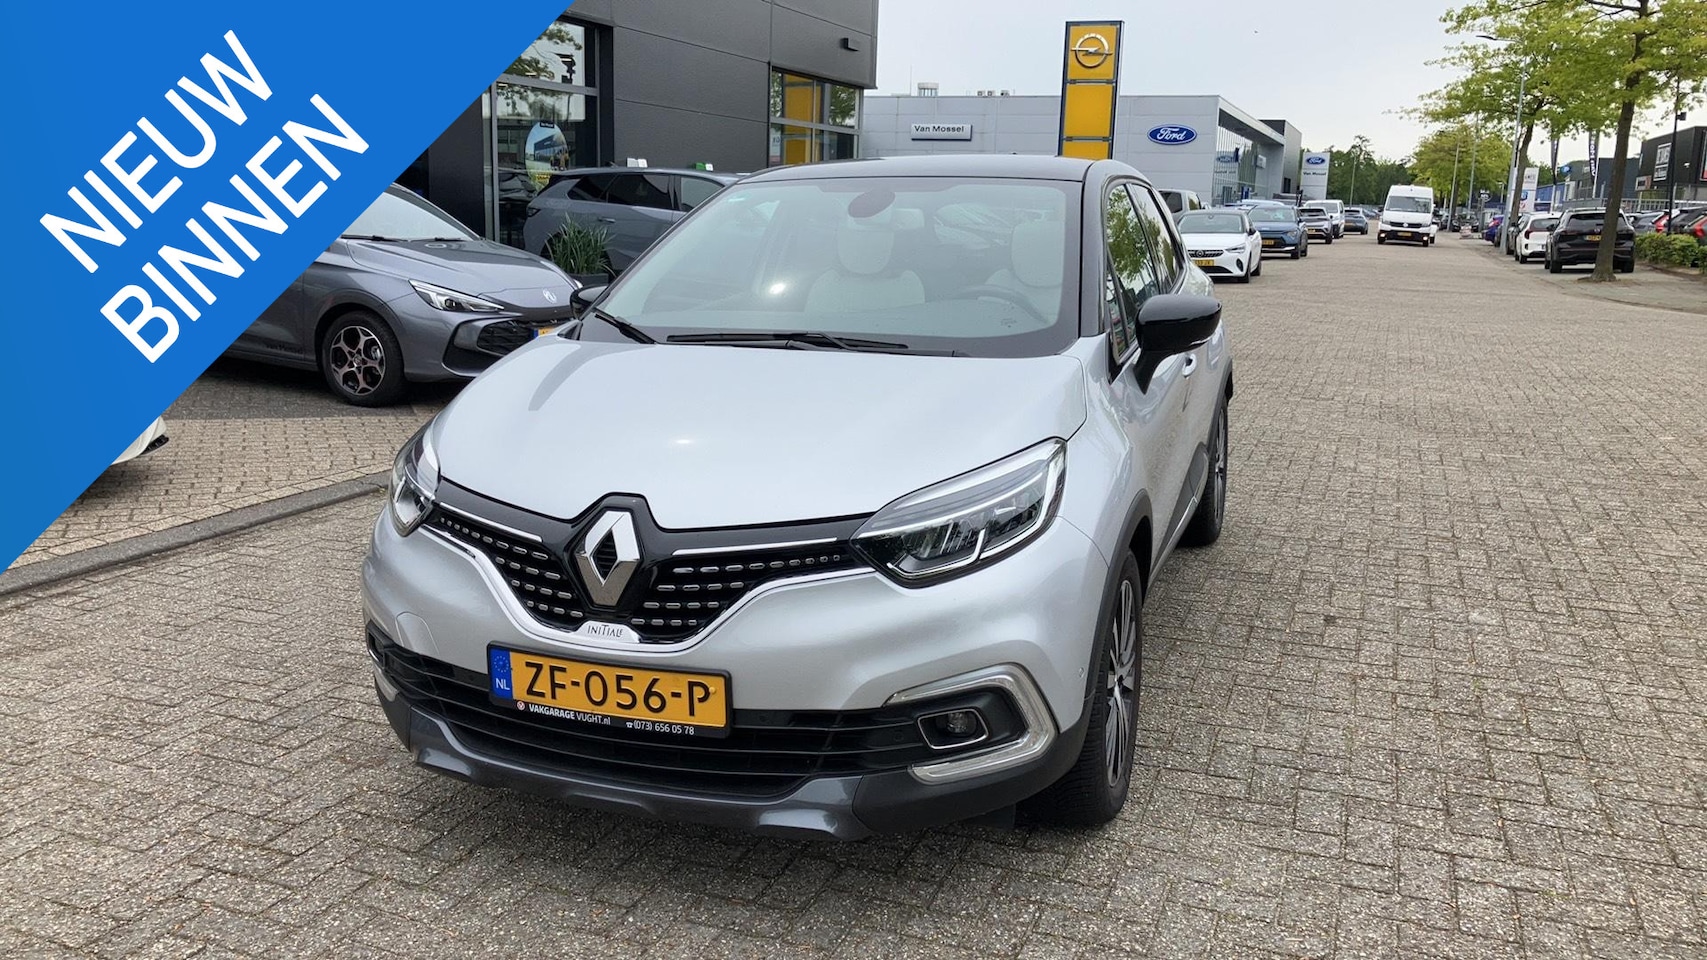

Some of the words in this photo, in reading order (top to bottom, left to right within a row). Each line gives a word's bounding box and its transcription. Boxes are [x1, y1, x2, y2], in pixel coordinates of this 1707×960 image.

[932, 125, 965, 133] Mossel
[1156, 127, 1187, 141] Ford
[587, 624, 624, 638] INITIALE
[495, 677, 510, 691] NL
[525, 661, 712, 717] ZF-056-P
[528, 703, 576, 720] VAKGARAGE
[576, 711, 611, 726] VUGHT.nl
[633, 719, 653, 731] (073)
[654, 722, 671, 733] 656
[671, 725, 682, 734] 05
[683, 725, 695, 736] 78
